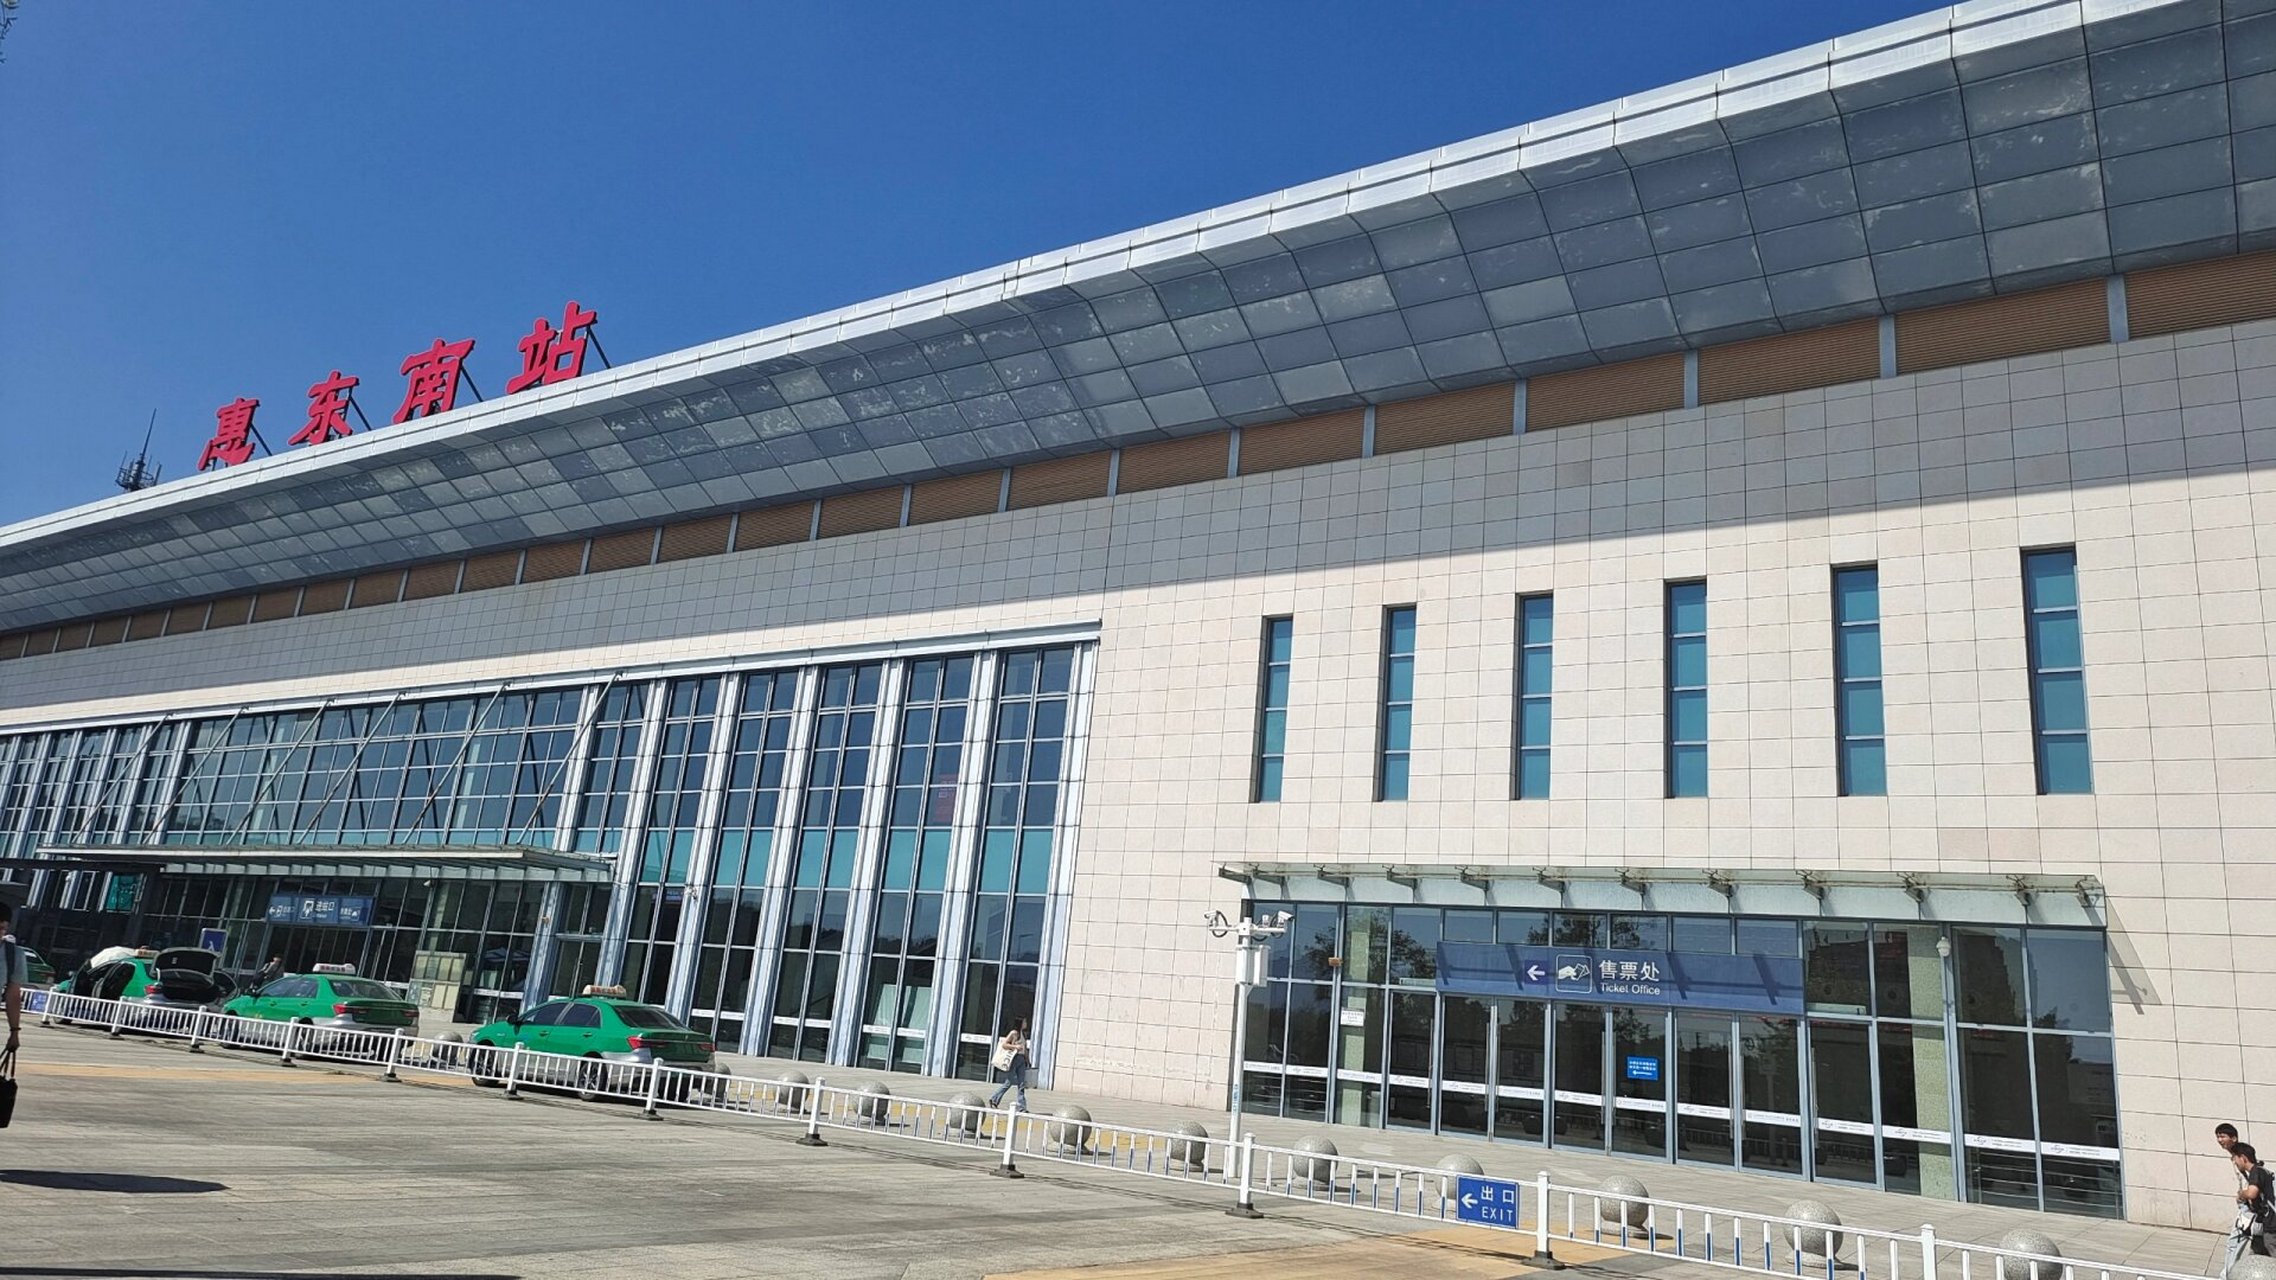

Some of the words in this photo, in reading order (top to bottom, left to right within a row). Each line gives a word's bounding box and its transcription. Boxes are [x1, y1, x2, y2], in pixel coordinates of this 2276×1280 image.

[197, 300, 597, 471] 惠东南站
[1599, 959, 1660, 982] 售票处
[1600, 982, 1629, 993] Ticket
[1631, 984, 1660, 996] Office
[1481, 1185, 1515, 1205] 出口
[1482, 1206, 1513, 1222] EXIT
